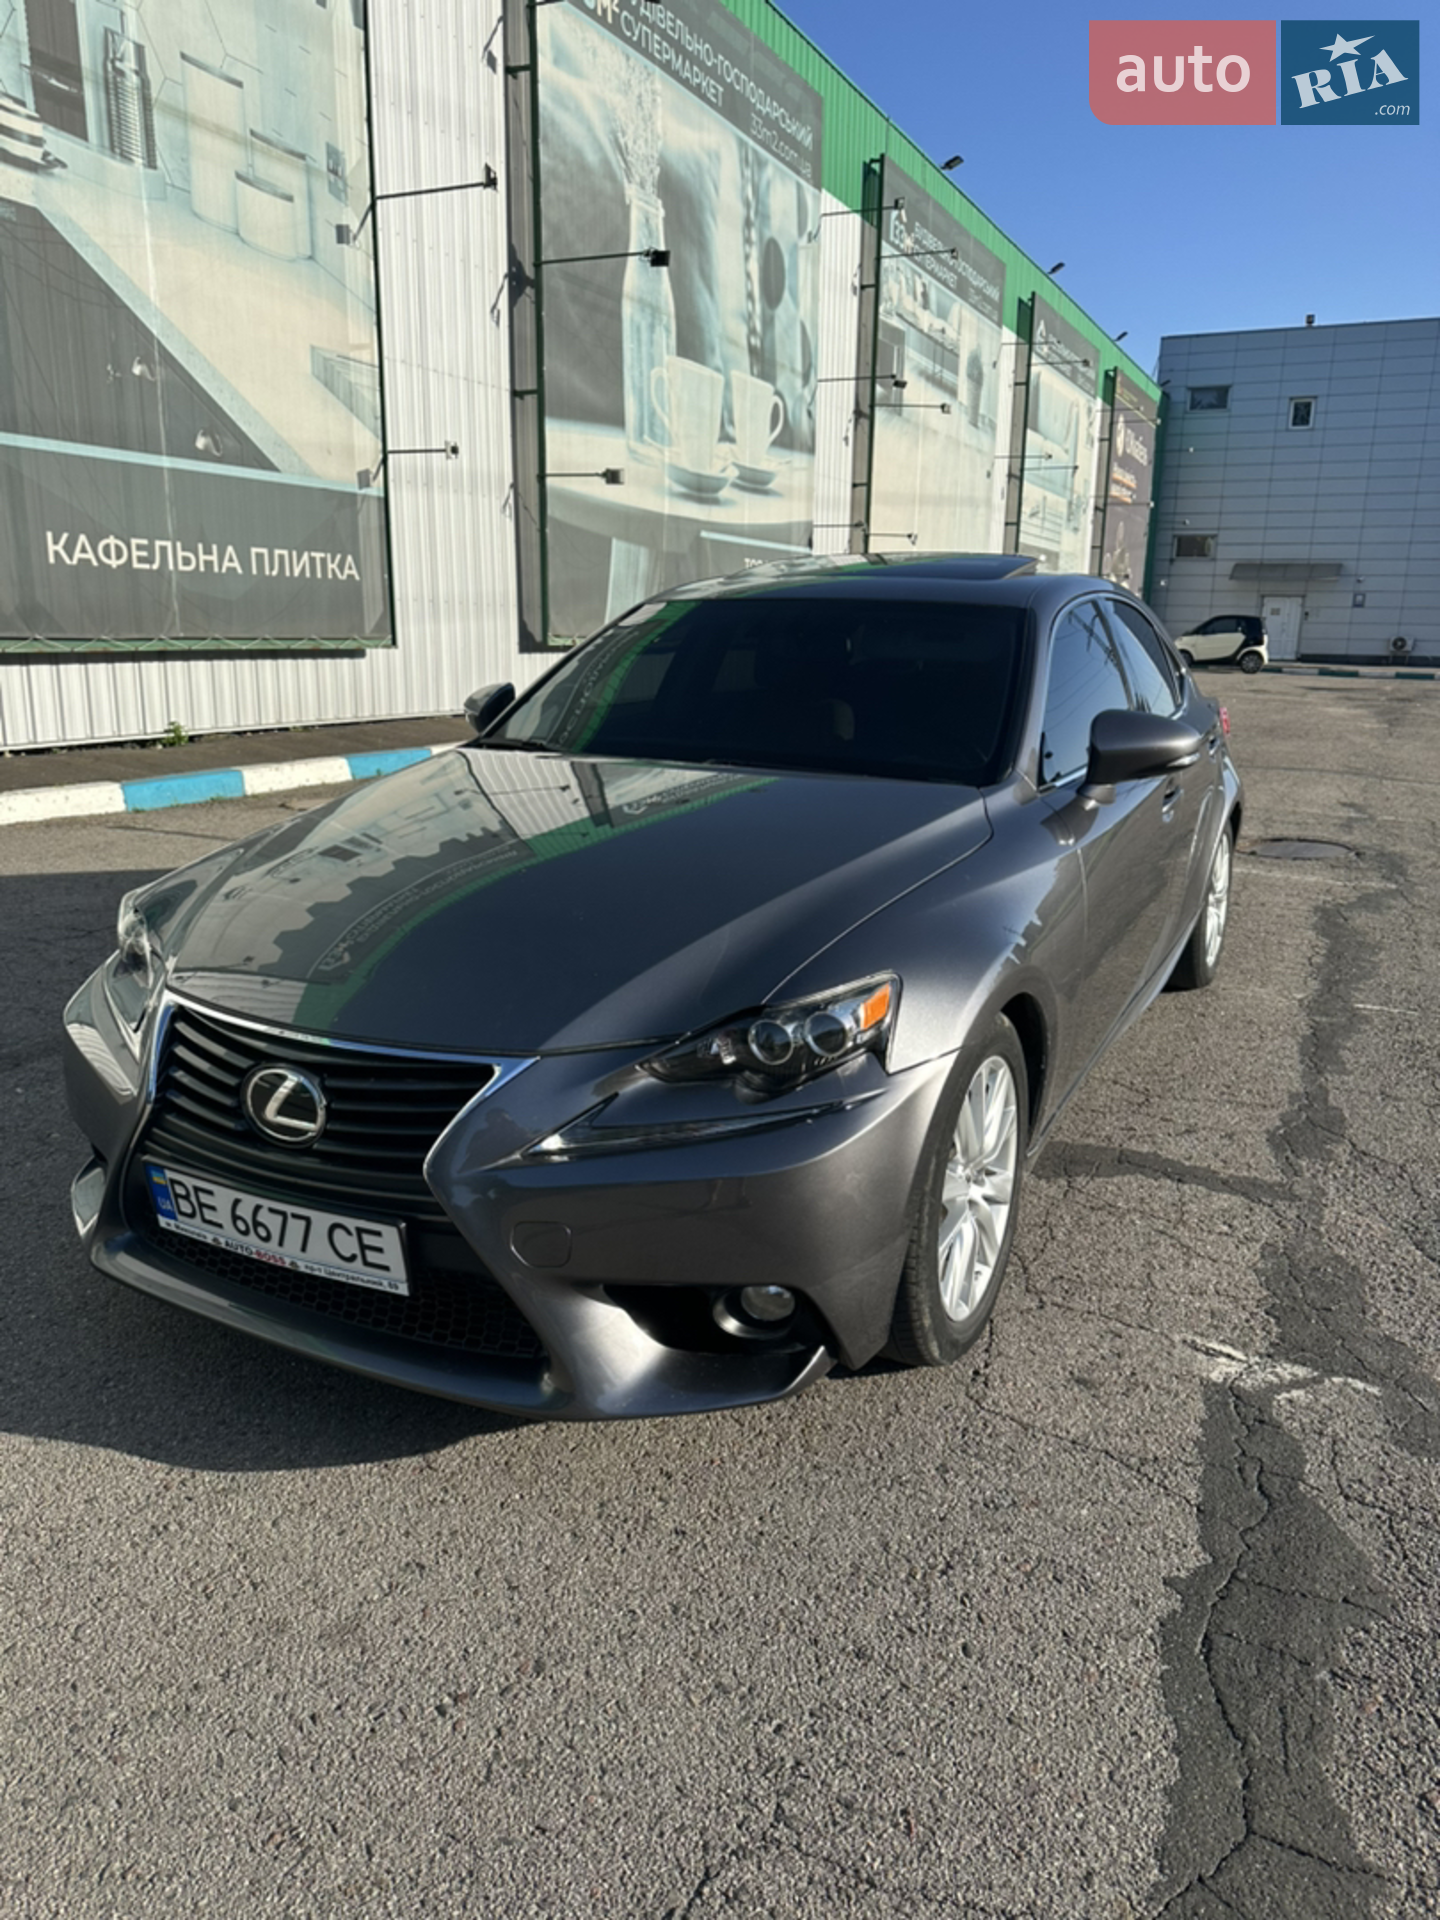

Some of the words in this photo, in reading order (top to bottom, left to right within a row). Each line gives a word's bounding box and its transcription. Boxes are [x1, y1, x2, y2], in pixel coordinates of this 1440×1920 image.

[620, 10, 724, 107] СУПЕРМАРКЕТ
[631, 0, 813, 151] ДІВЕЛЬНО-ГОСПОДАРСЬКИЙ
[46, 531, 243, 575] КАФЕЛЬНА
[250, 547, 360, 581] ПЛИТКА
[167, 1177, 224, 1229] BE
[231, 1198, 312, 1253] 6677
[327, 1222, 391, 1272] CE
